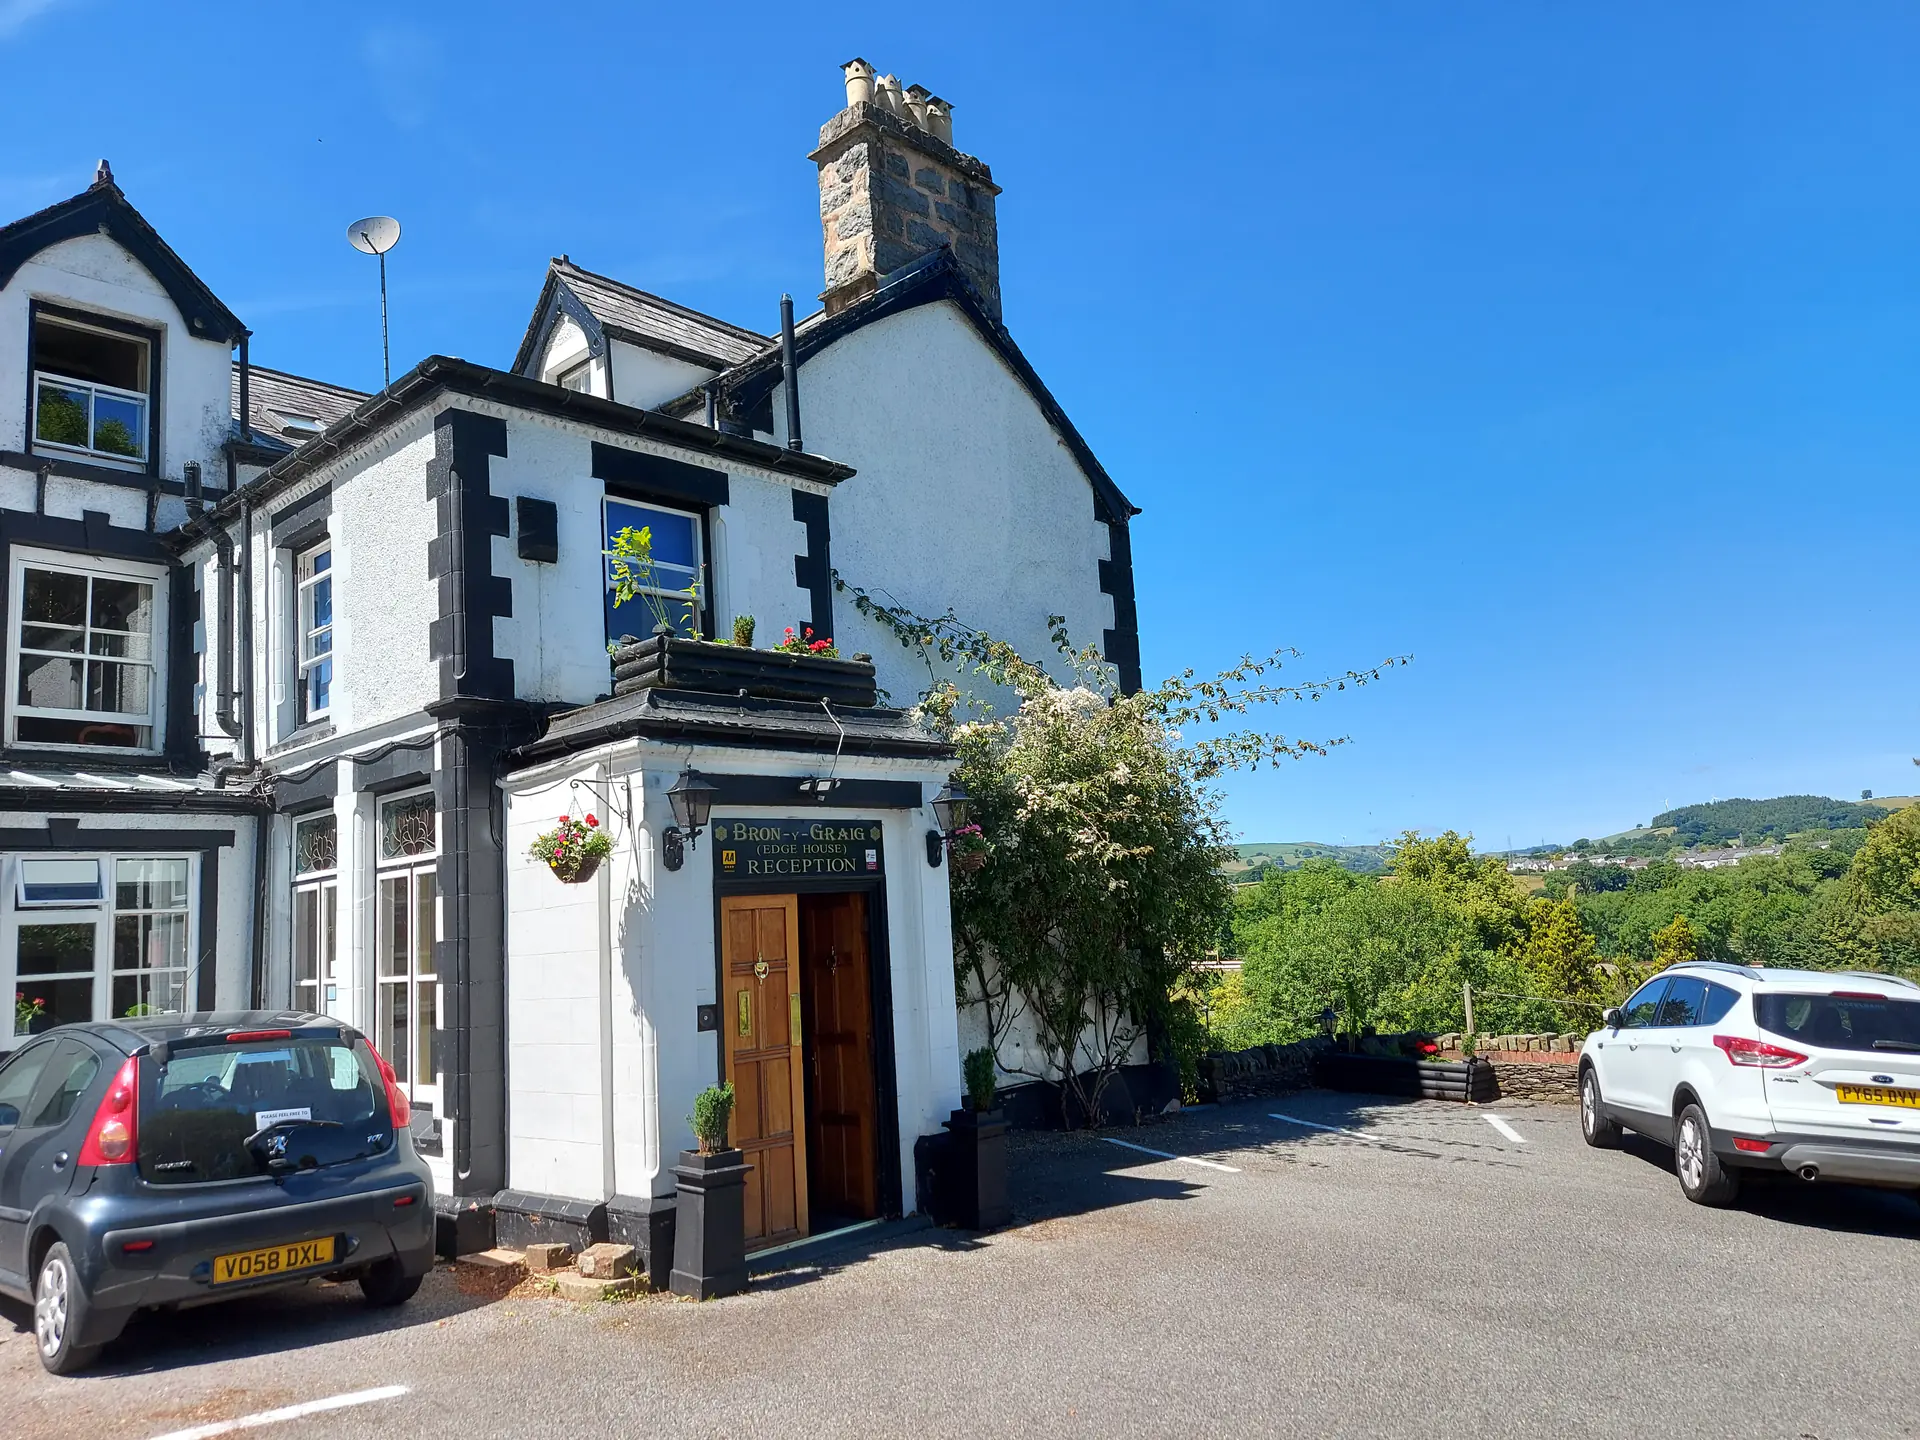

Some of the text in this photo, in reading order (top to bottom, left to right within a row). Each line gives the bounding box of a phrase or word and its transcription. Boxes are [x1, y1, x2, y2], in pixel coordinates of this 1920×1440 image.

[724, 852, 735, 862] AA
[756, 843, 847, 856] (EDGE HOUSE)
[747, 858, 857, 875] RECEPTION
[1843, 1086, 1917, 1105] PY65 DVV
[224, 1243, 325, 1278] VO58 DXL
